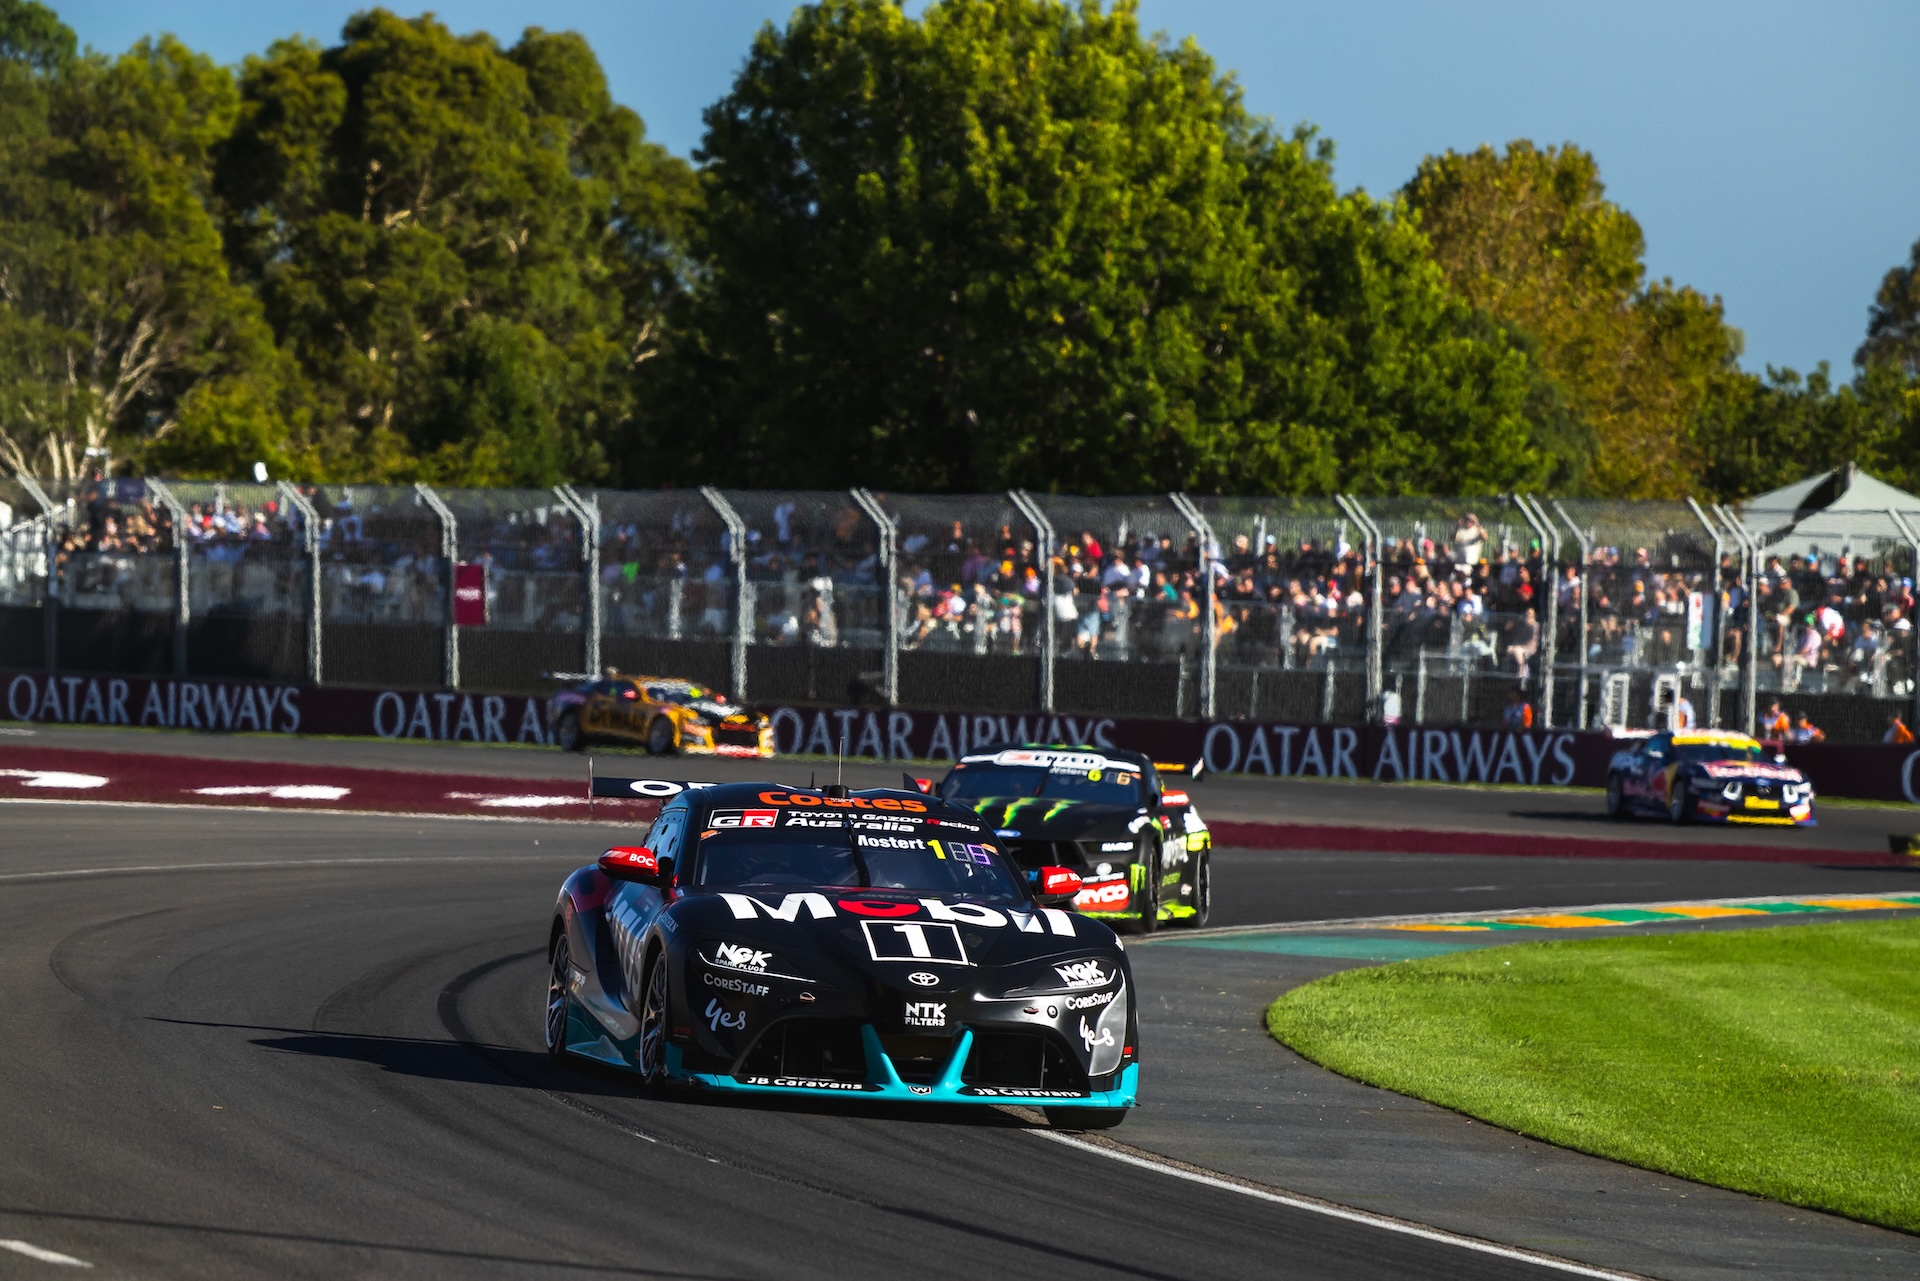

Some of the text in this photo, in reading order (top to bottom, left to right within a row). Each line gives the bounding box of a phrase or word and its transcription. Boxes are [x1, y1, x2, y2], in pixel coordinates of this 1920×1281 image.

[8, 674, 300, 733] QATAR AIRWAYS
[373, 691, 507, 742] QATAR
[772, 707, 1116, 761] QATAR AIRWAYS
[1203, 722, 1575, 786] QATAR AIRWAYS
[758, 791, 928, 813] Coates
[711, 815, 775, 827] GR
[862, 813, 923, 824] GAZOO
[926, 818, 980, 832] Racing
[629, 853, 655, 867] BOC
[927, 839, 946, 860] 1
[893, 924, 931, 958] 1
[716, 942, 773, 967] NGK
[714, 958, 765, 973] SPARK PLUGS
[1054, 960, 1105, 982] NGK
[905, 1002, 947, 1018] NTK
[904, 1017, 946, 1027] FILTERS
[747, 1077, 863, 1090] JB Caravans
